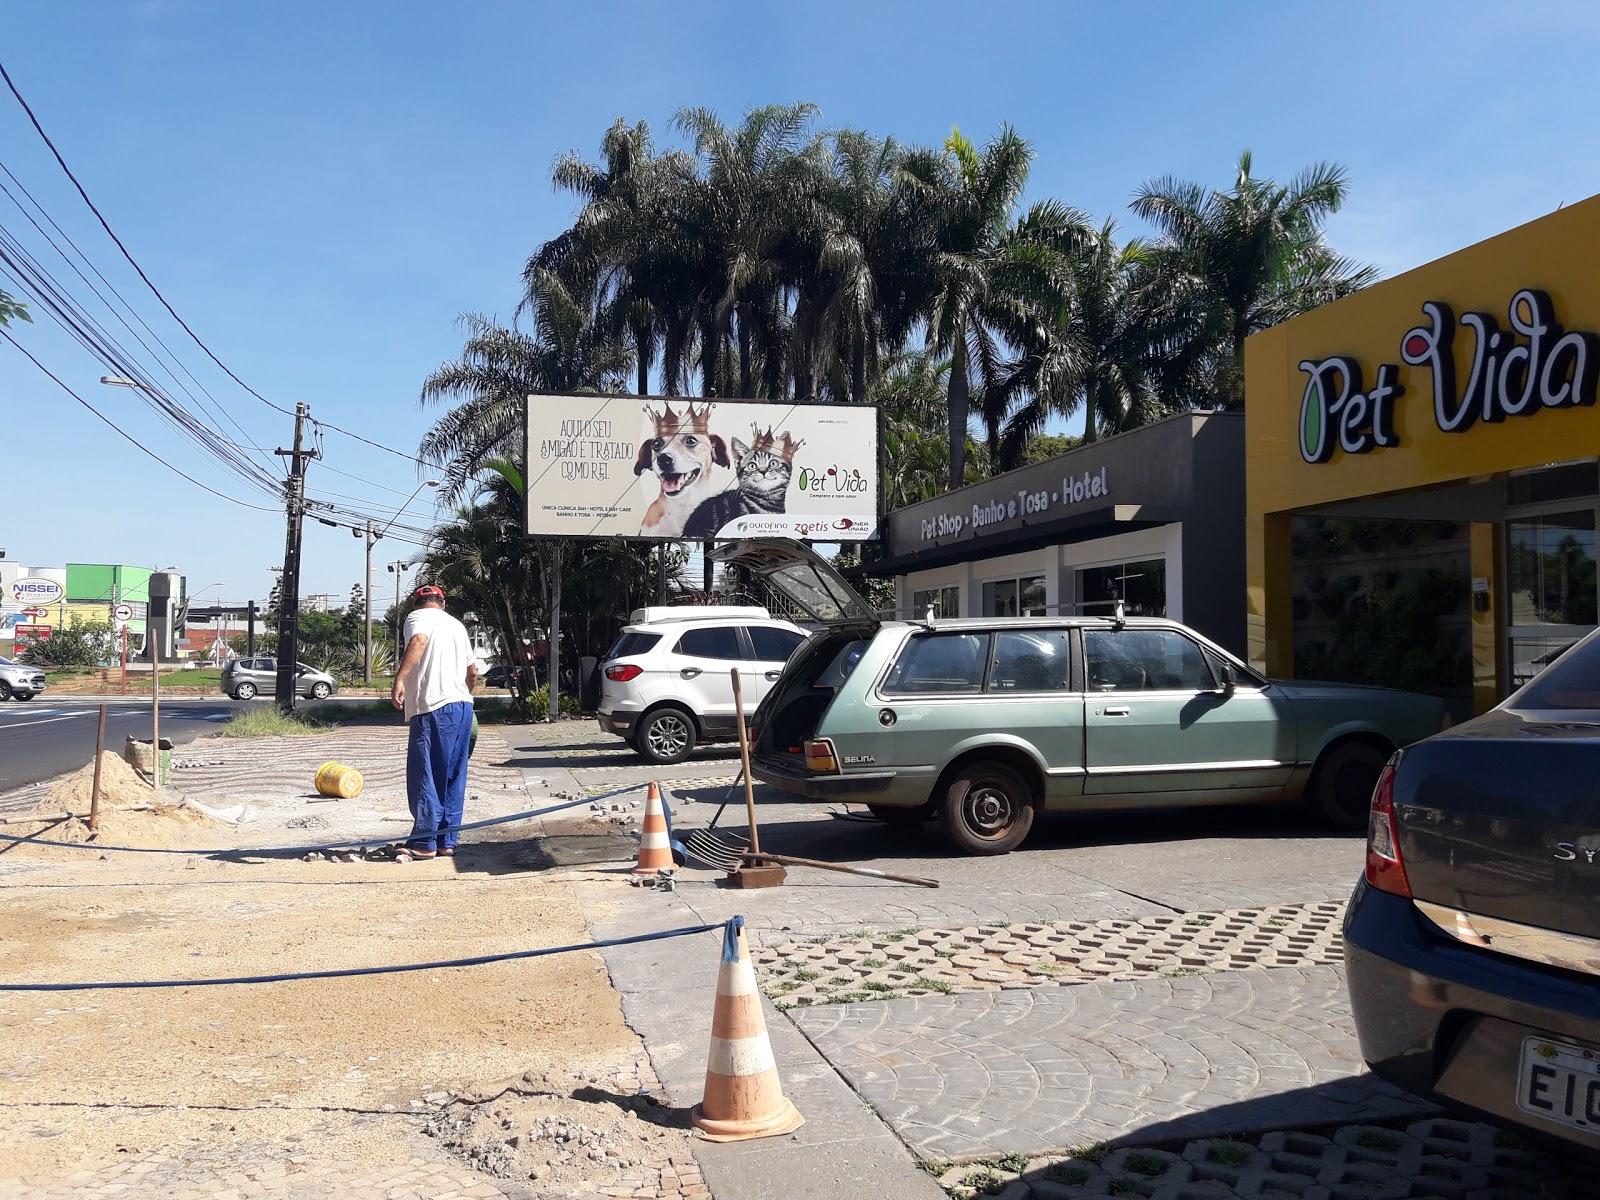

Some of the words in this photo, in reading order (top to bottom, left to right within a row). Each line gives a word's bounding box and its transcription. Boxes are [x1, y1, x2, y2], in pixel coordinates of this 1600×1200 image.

[1299, 356, 1398, 463] Pet
[1401, 289, 1592, 432] Vida
[560, 419, 583, 439] AQUI
[584, 420, 592, 437] O
[592, 420, 612, 438] SEU
[540, 439, 578, 459] AMIGÃO
[580, 439, 586, 458] É
[588, 441, 634, 460] TRATADO
[561, 461, 590, 481] COMO
[591, 462, 610, 481] REI.
[799, 466, 828, 491] Pet
[827, 464, 868, 492] Vida
[921, 517, 938, 540] Pet
[938, 513, 963, 537] Shop
[972, 499, 1005, 528] Banho
[1007, 503, 1017, 519] e
[1018, 490, 1049, 516] Tosa
[1063, 466, 1109, 505] Hotel
[749, 521, 788, 530] ourofino
[794, 520, 829, 533] zoetis
[13, 584, 59, 593] NISSEI
[844, 755, 876, 764] BELINA
